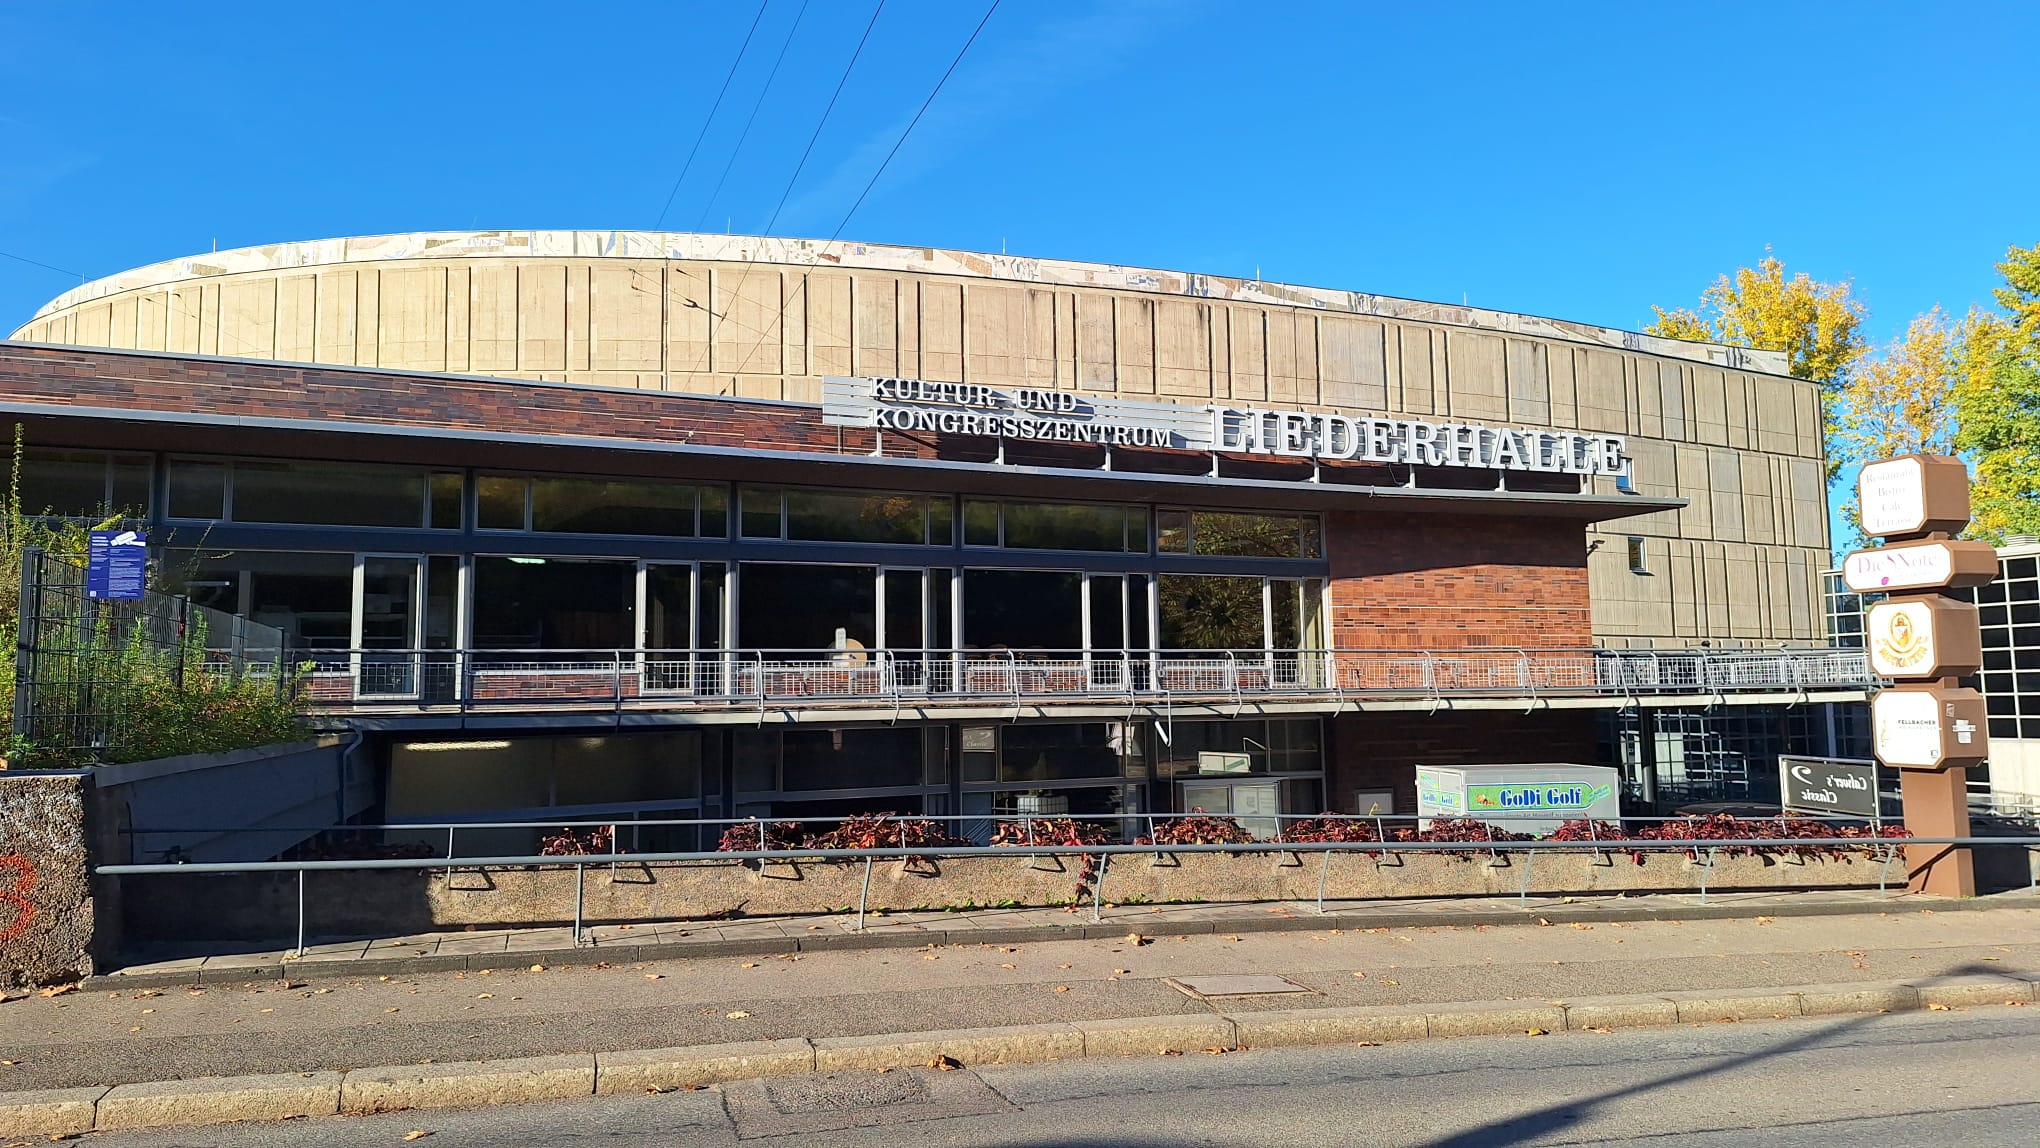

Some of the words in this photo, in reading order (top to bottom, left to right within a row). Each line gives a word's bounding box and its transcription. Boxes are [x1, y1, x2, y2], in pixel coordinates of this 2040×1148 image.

[869, 376, 996, 407] KULTUR
[1012, 388, 1078, 413] UND
[869, 407, 1173, 449] KONGRESSZENTRUM
[1208, 404, 1626, 477] LIEDERHALLE
[1858, 556, 1884, 574] Die
[1499, 788, 1541, 807] GoDi
[1546, 787, 1582, 807] Golf
